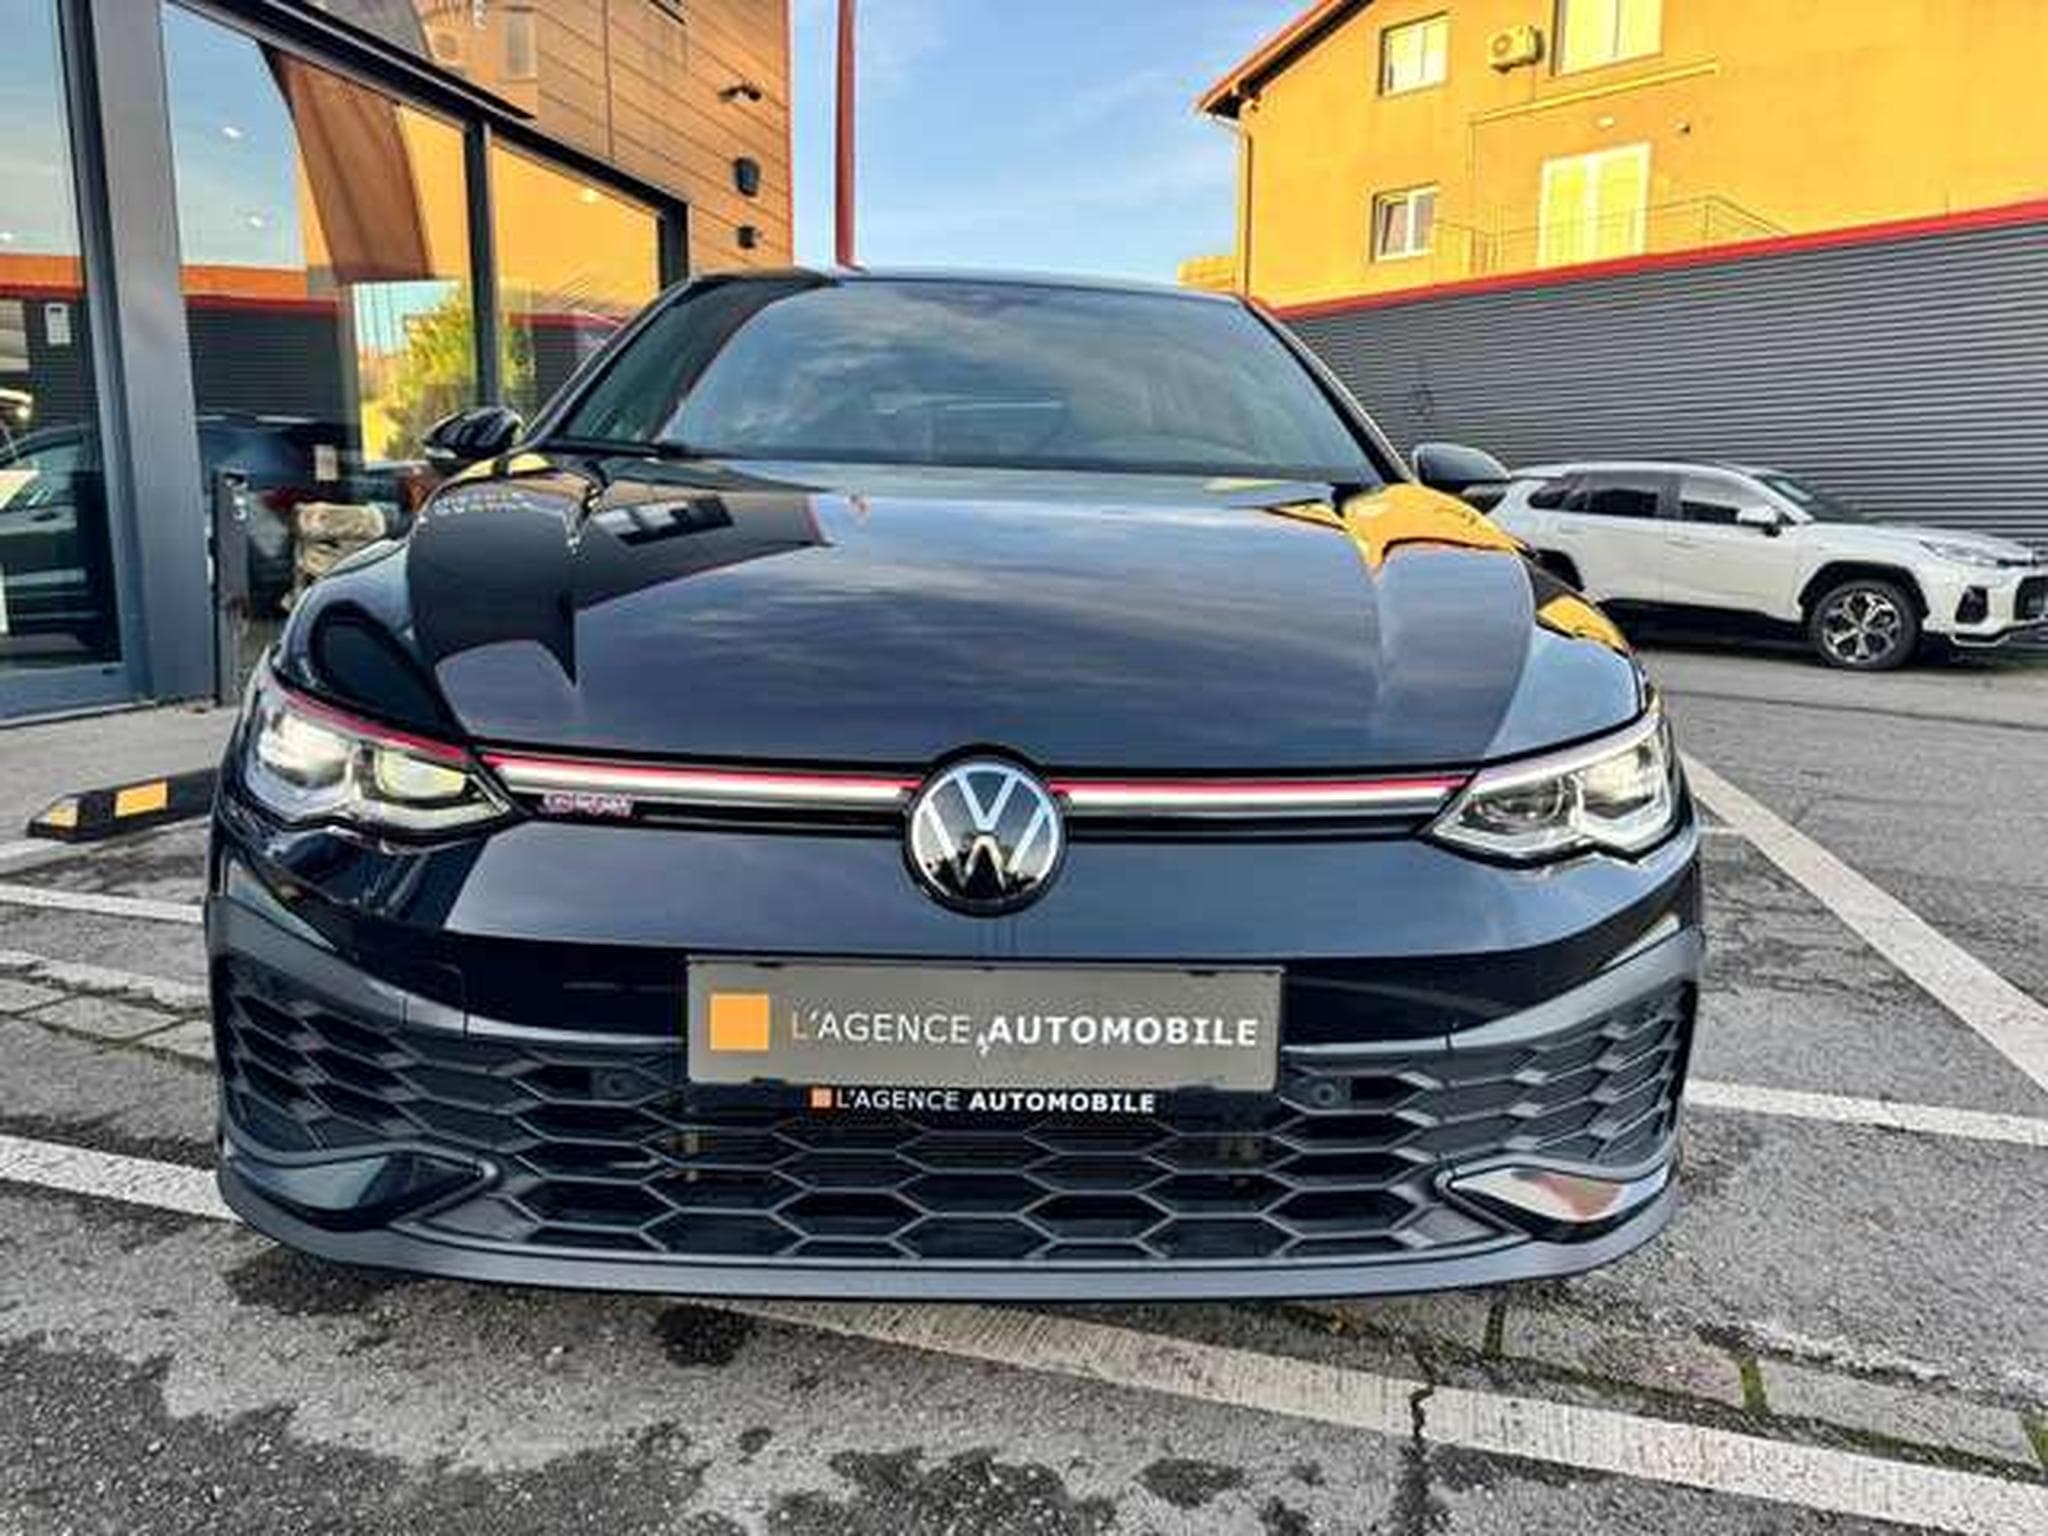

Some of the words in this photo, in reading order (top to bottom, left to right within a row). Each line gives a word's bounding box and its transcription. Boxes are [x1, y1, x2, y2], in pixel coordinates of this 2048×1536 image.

[791, 1011, 970, 1044] L'AGENCE
[987, 1015, 1259, 1046] AUTOMOBILE
[836, 1088, 960, 1111] L'AGENCE
[968, 1091, 1156, 1114] AUTOMOBILE
